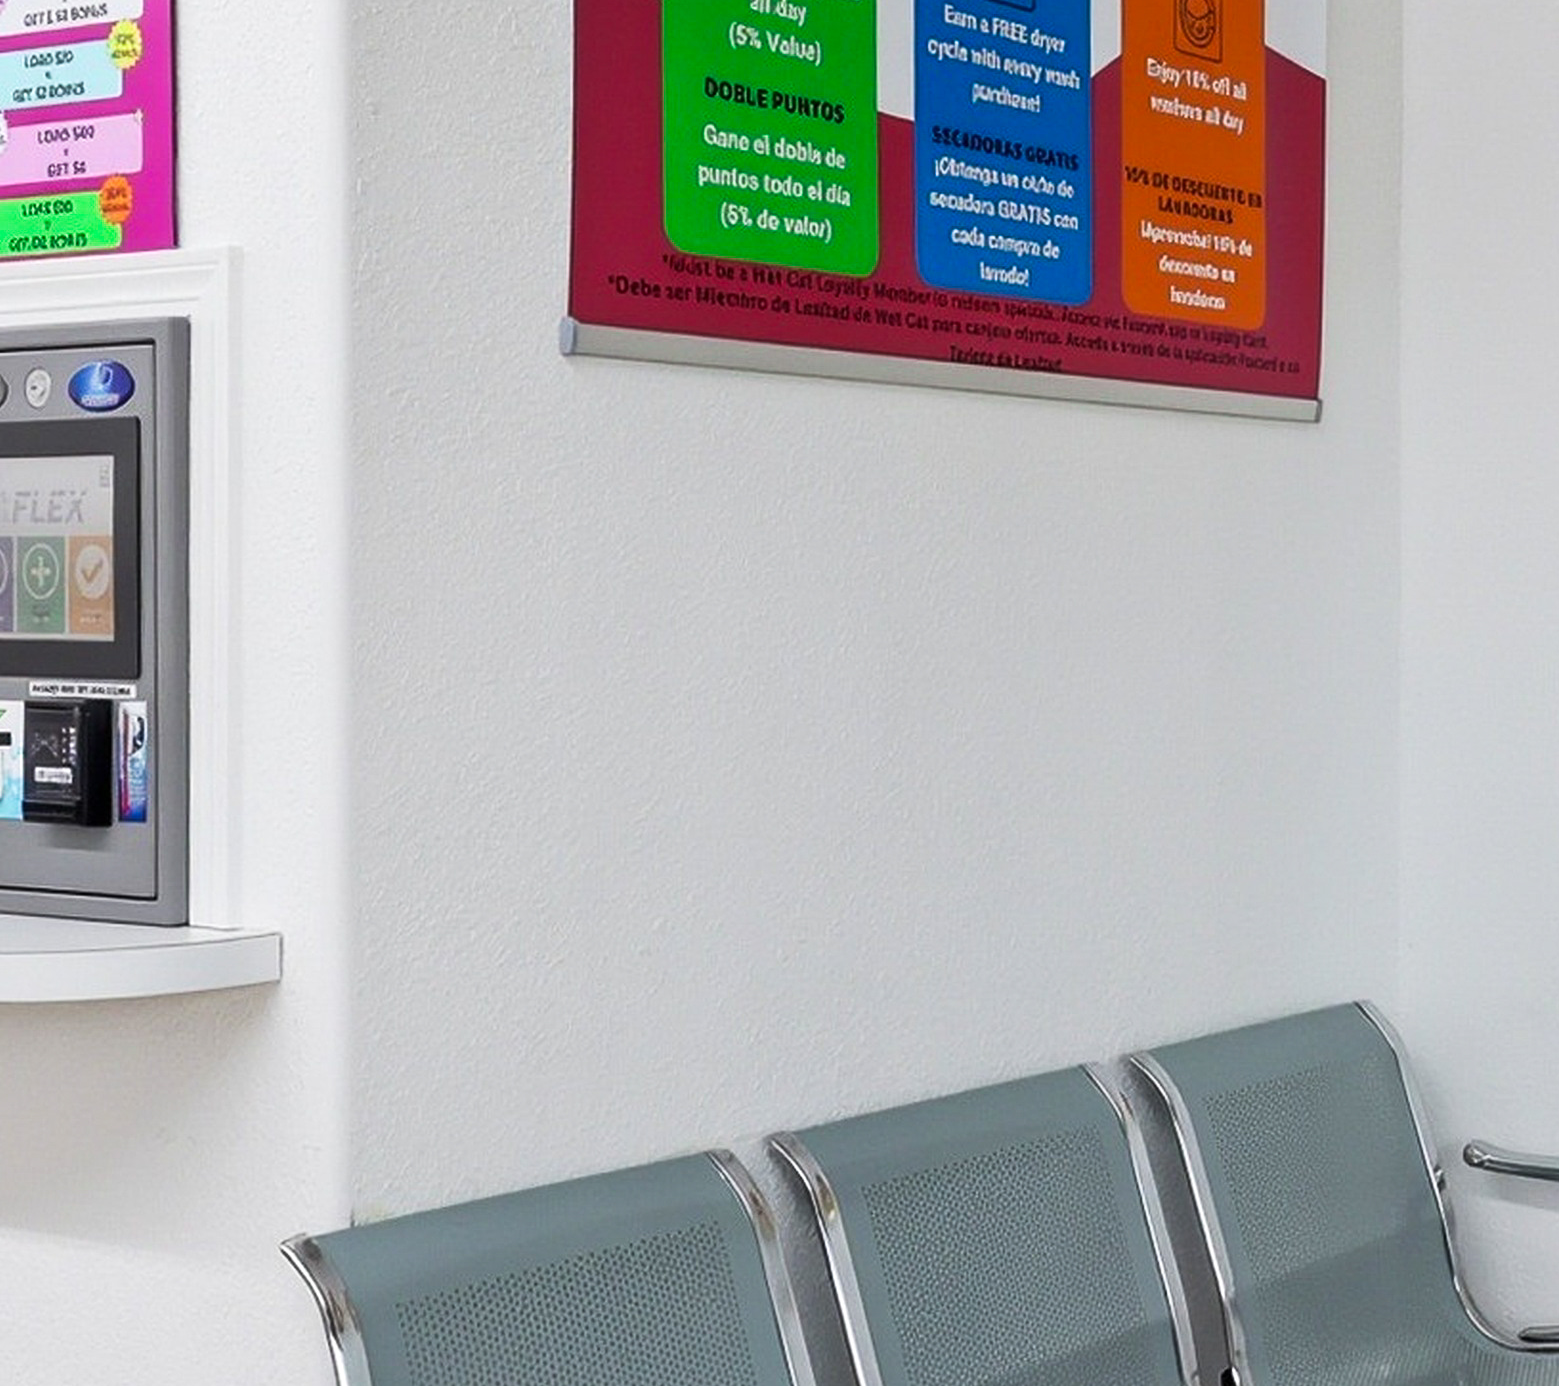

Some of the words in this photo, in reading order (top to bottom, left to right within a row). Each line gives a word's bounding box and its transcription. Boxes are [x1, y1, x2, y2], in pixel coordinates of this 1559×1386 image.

[729, 21, 762, 49] (5%
[766, 30, 822, 66] Value)
[943, 3, 978, 31] Earn
[980, 18, 990, 34] a
[991, 17, 1028, 43] FREE
[1030, 28, 1066, 55] dryer
[927, 39, 968, 61] cycle
[971, 47, 1001, 70] with
[1003, 58, 1042, 84] every
[1044, 67, 1081, 90] wash
[704, 76, 769, 109] DOBLE
[772, 90, 845, 123] PUNTOS
[703, 123, 749, 151] Gane
[753, 134, 770, 155] el
[774, 137, 822, 164] doble
[825, 147, 846, 169] de
[931, 125, 1022, 160] SECADORAS
[1025, 145, 1079, 171] GRATIS
[698, 165, 759, 191] puntos
[763, 173, 804, 197] todo
[807, 181, 823, 202] el
[1001, 171, 1020, 189] un
[1056, 178, 1074, 199] de
[756, 208, 779, 231] de
[783, 215, 833, 243] valor)
[998, 200, 1051, 226] GRATIS
[950, 226, 985, 249] cada
[1042, 239, 1060, 259] de
